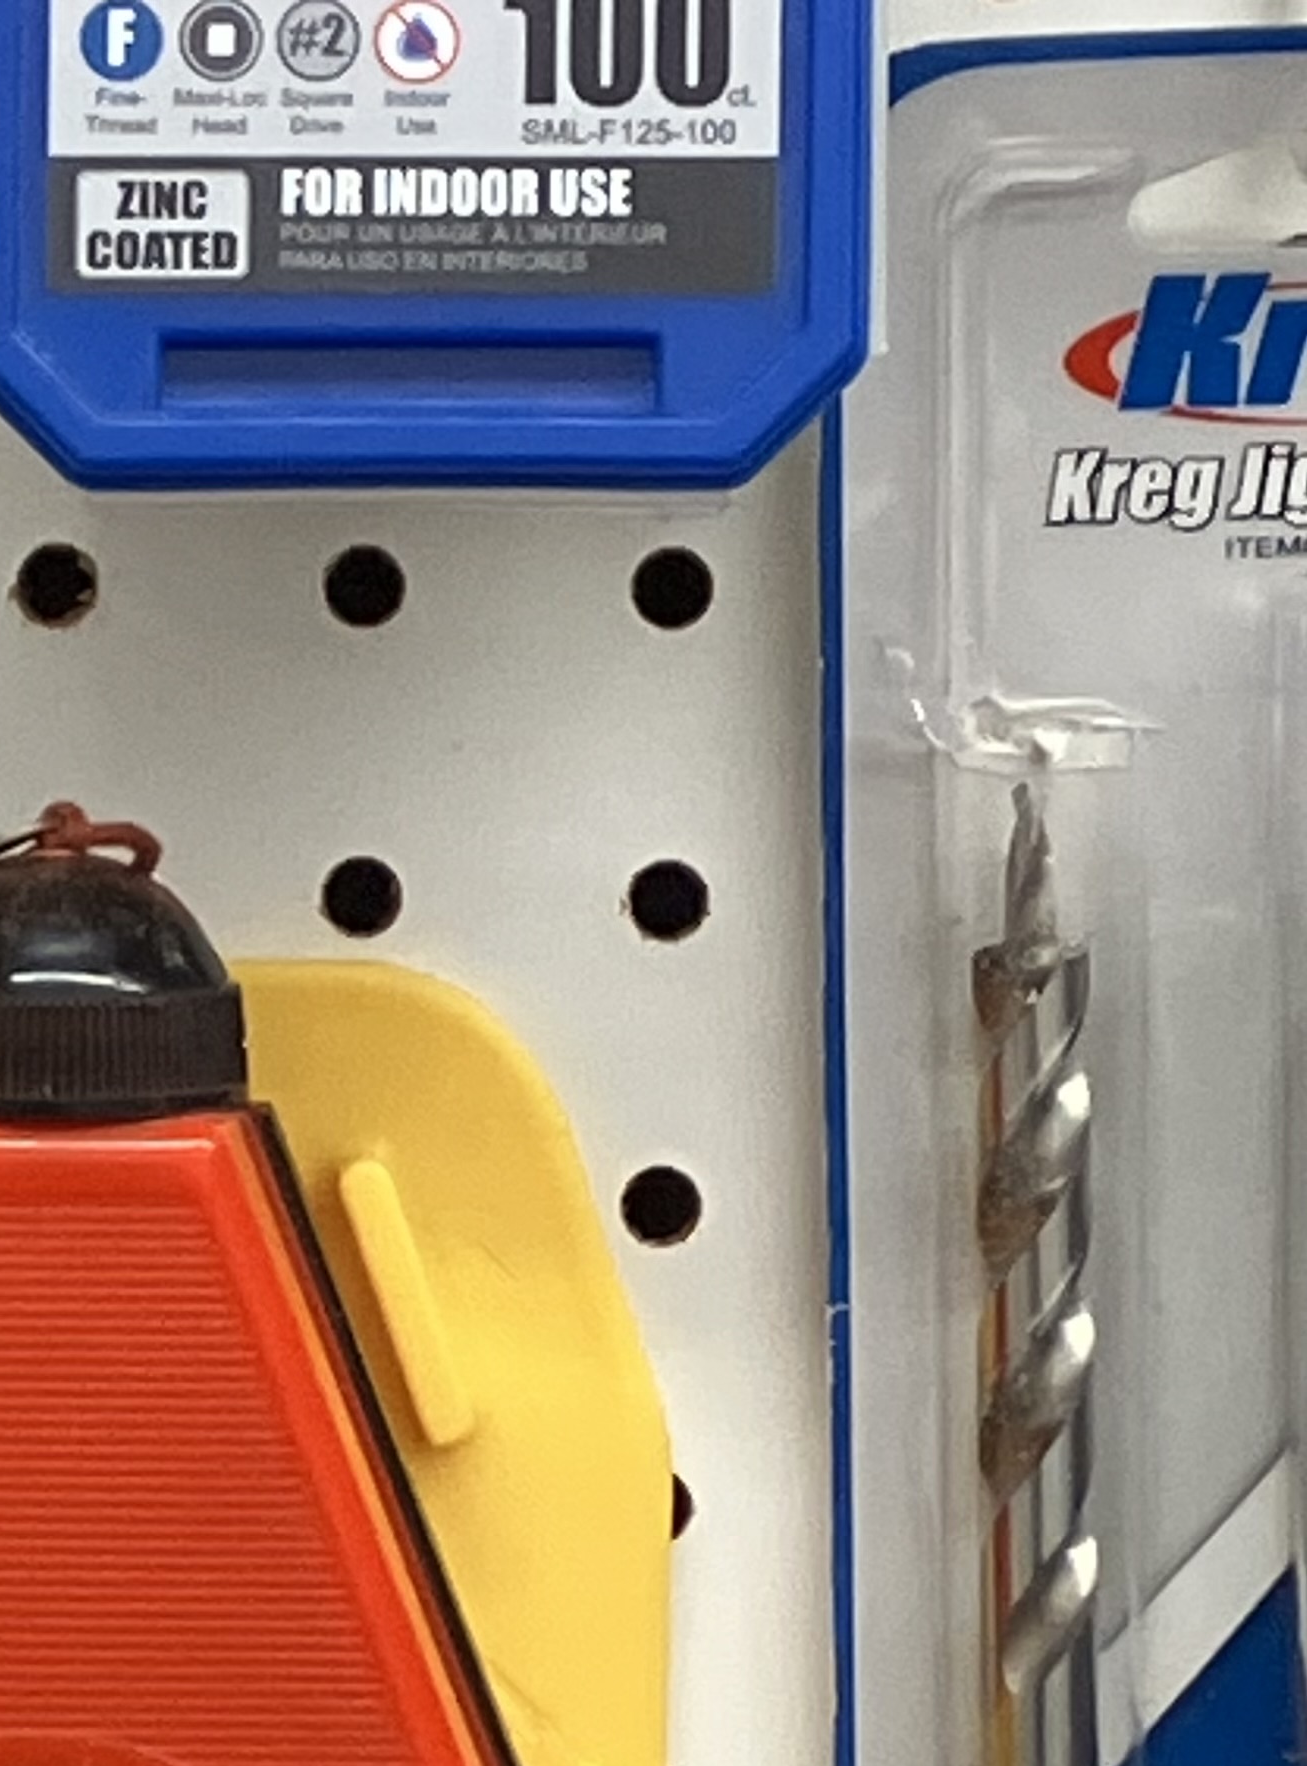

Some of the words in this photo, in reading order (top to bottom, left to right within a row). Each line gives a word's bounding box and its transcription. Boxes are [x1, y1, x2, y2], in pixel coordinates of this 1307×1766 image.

[502, 0, 731, 107] 100
[116, 180, 208, 220] ZINC
[280, 168, 363, 217] FOR
[373, 168, 539, 217] INDOOR
[549, 168, 633, 217] USE
[86, 230, 239, 270] COATED
[1044, 446, 1225, 533] Kreg
